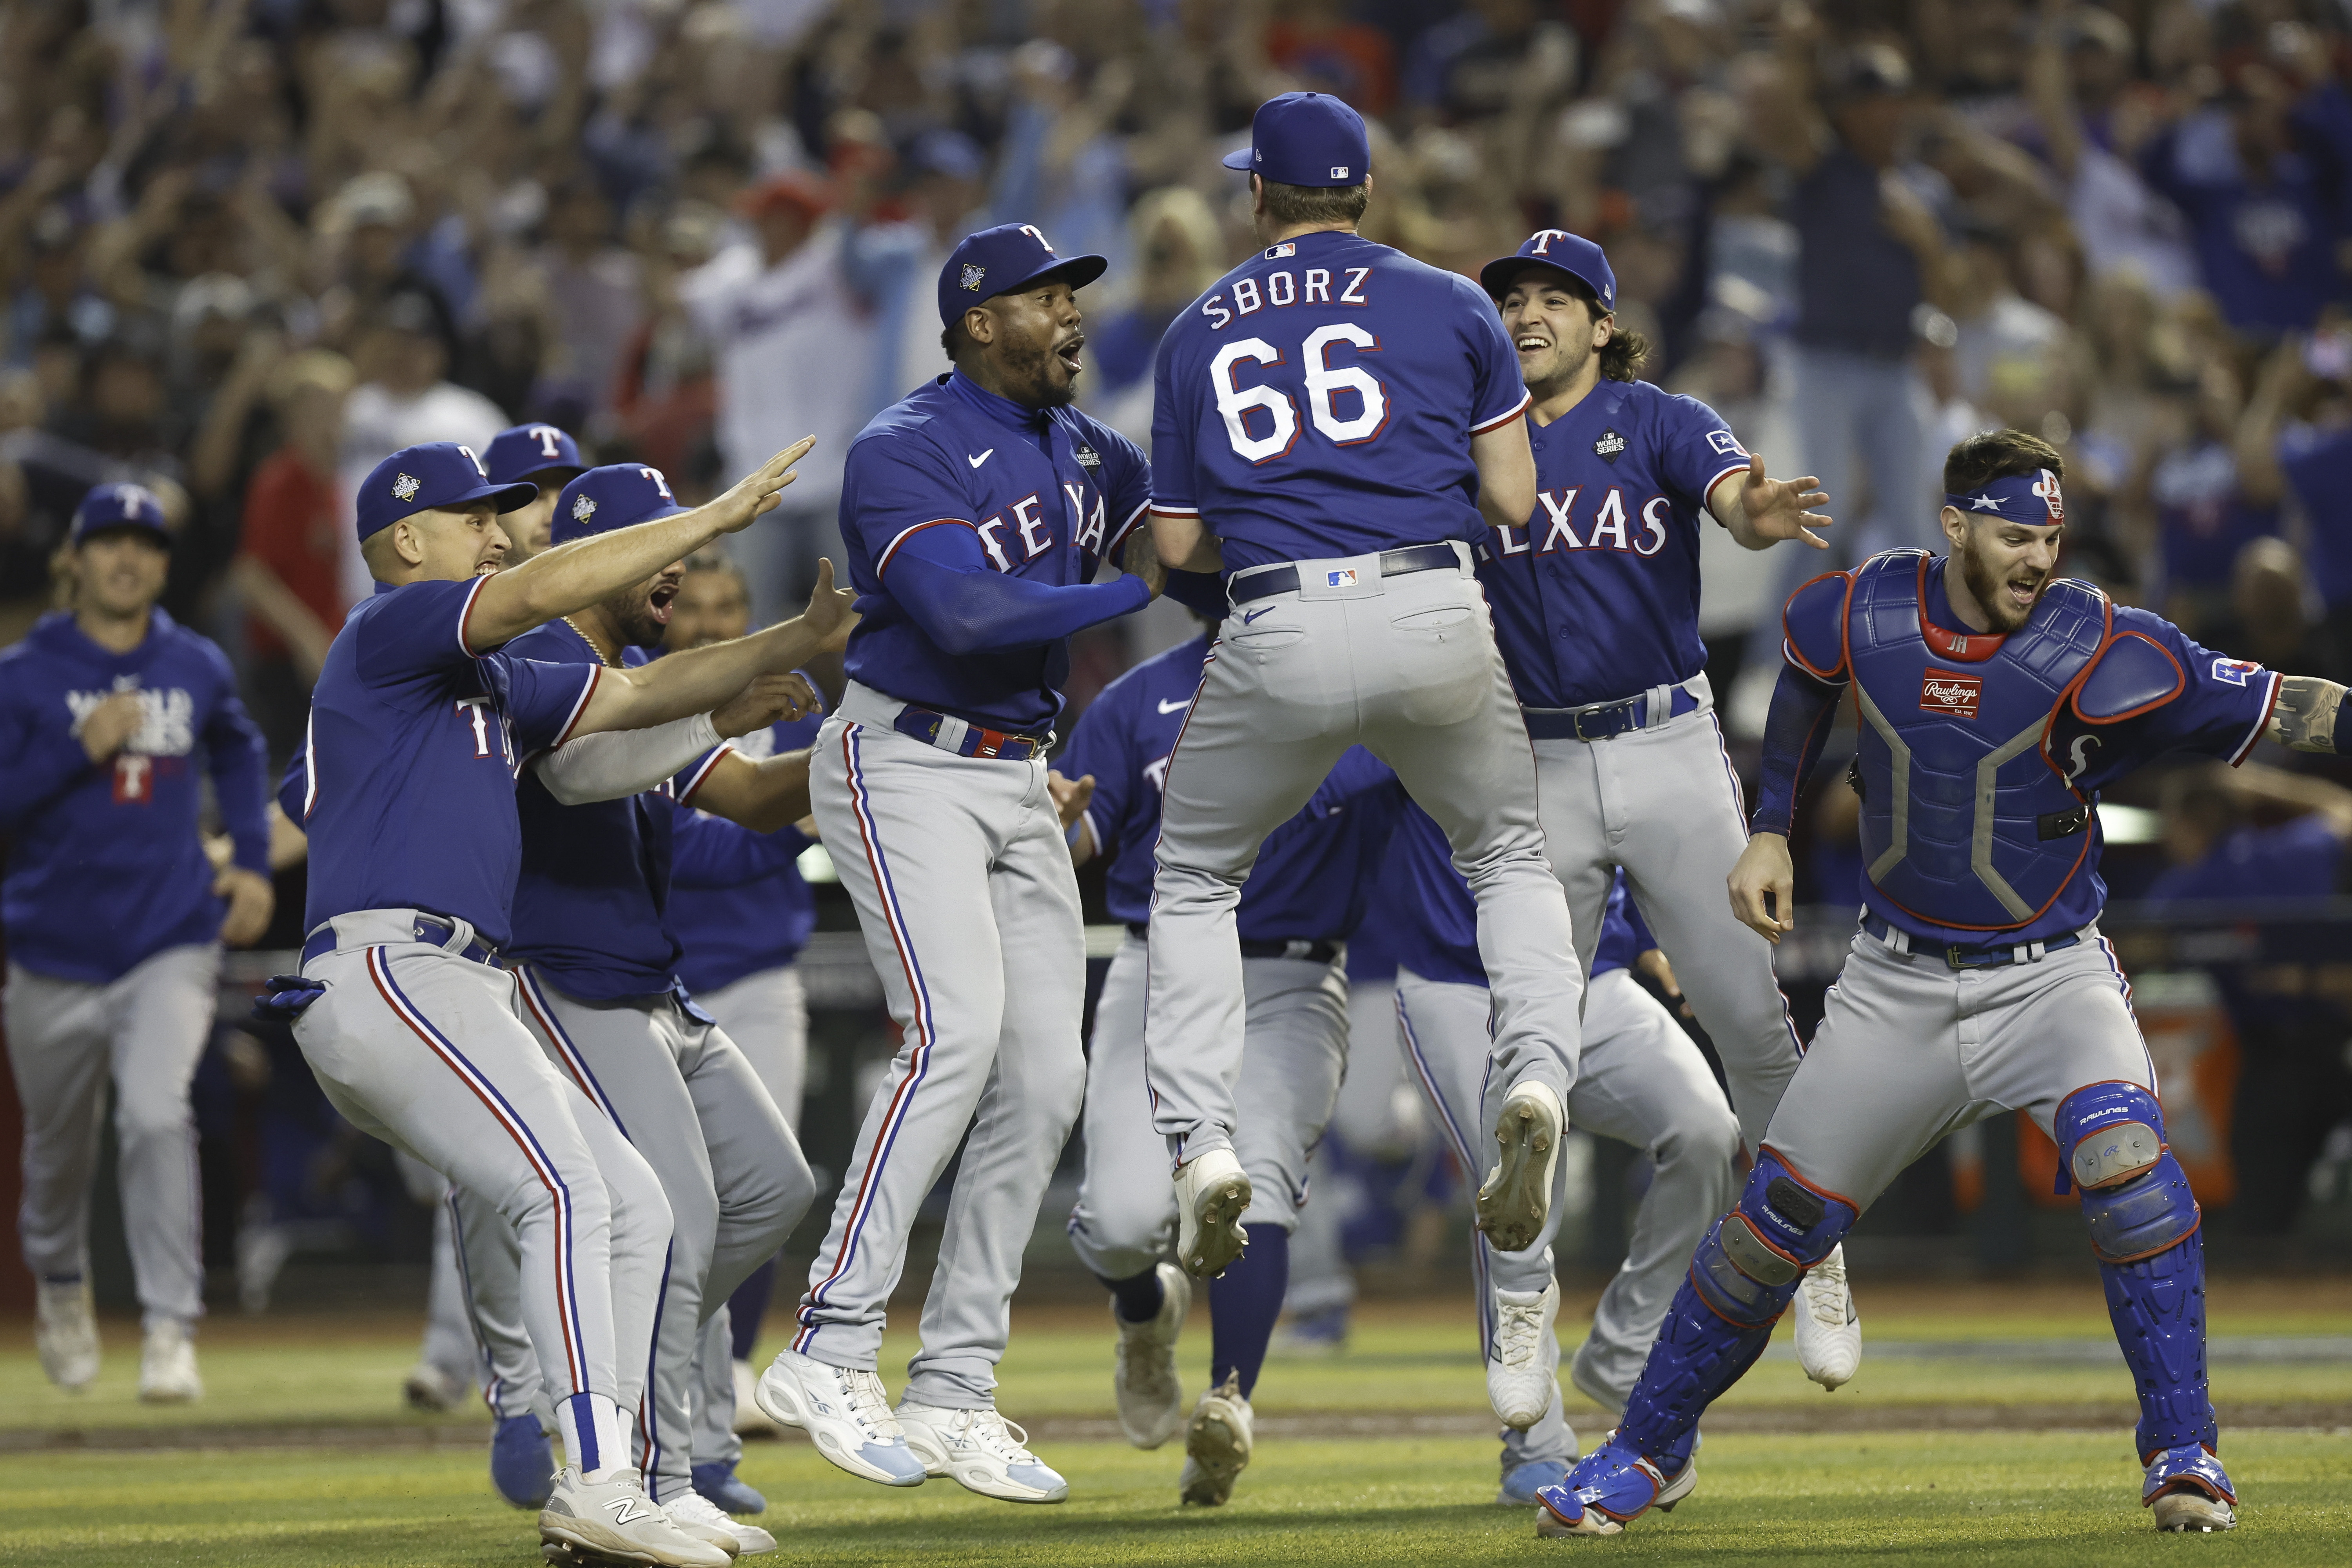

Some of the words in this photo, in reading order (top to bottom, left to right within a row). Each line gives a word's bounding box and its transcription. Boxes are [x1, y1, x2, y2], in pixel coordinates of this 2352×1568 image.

[1019, 225, 1055, 253] T
[1531, 230, 1565, 256] T
[960, 267, 981, 284] WORLD
[963, 272, 984, 289] SERIES
[1202, 267, 1372, 330] SBORZ
[1208, 323, 1390, 466] 66
[529, 426, 562, 459] T
[1596, 437, 1623, 448] WORLD
[1597, 443, 1624, 455] SERIES
[457, 446, 486, 478] T
[1079, 458, 1101, 466] SERIES
[393, 478, 417, 492] WORLD
[395, 483, 419, 498] SERIES
[639, 468, 671, 500] T
[114, 484, 151, 519] T
[1947, 635, 1968, 654] JH
[1924, 682, 1978, 703] Rawlings
[2080, 1107, 2129, 1126] RAWLINGS
[1762, 1204, 1805, 1236] RAWLINGS
